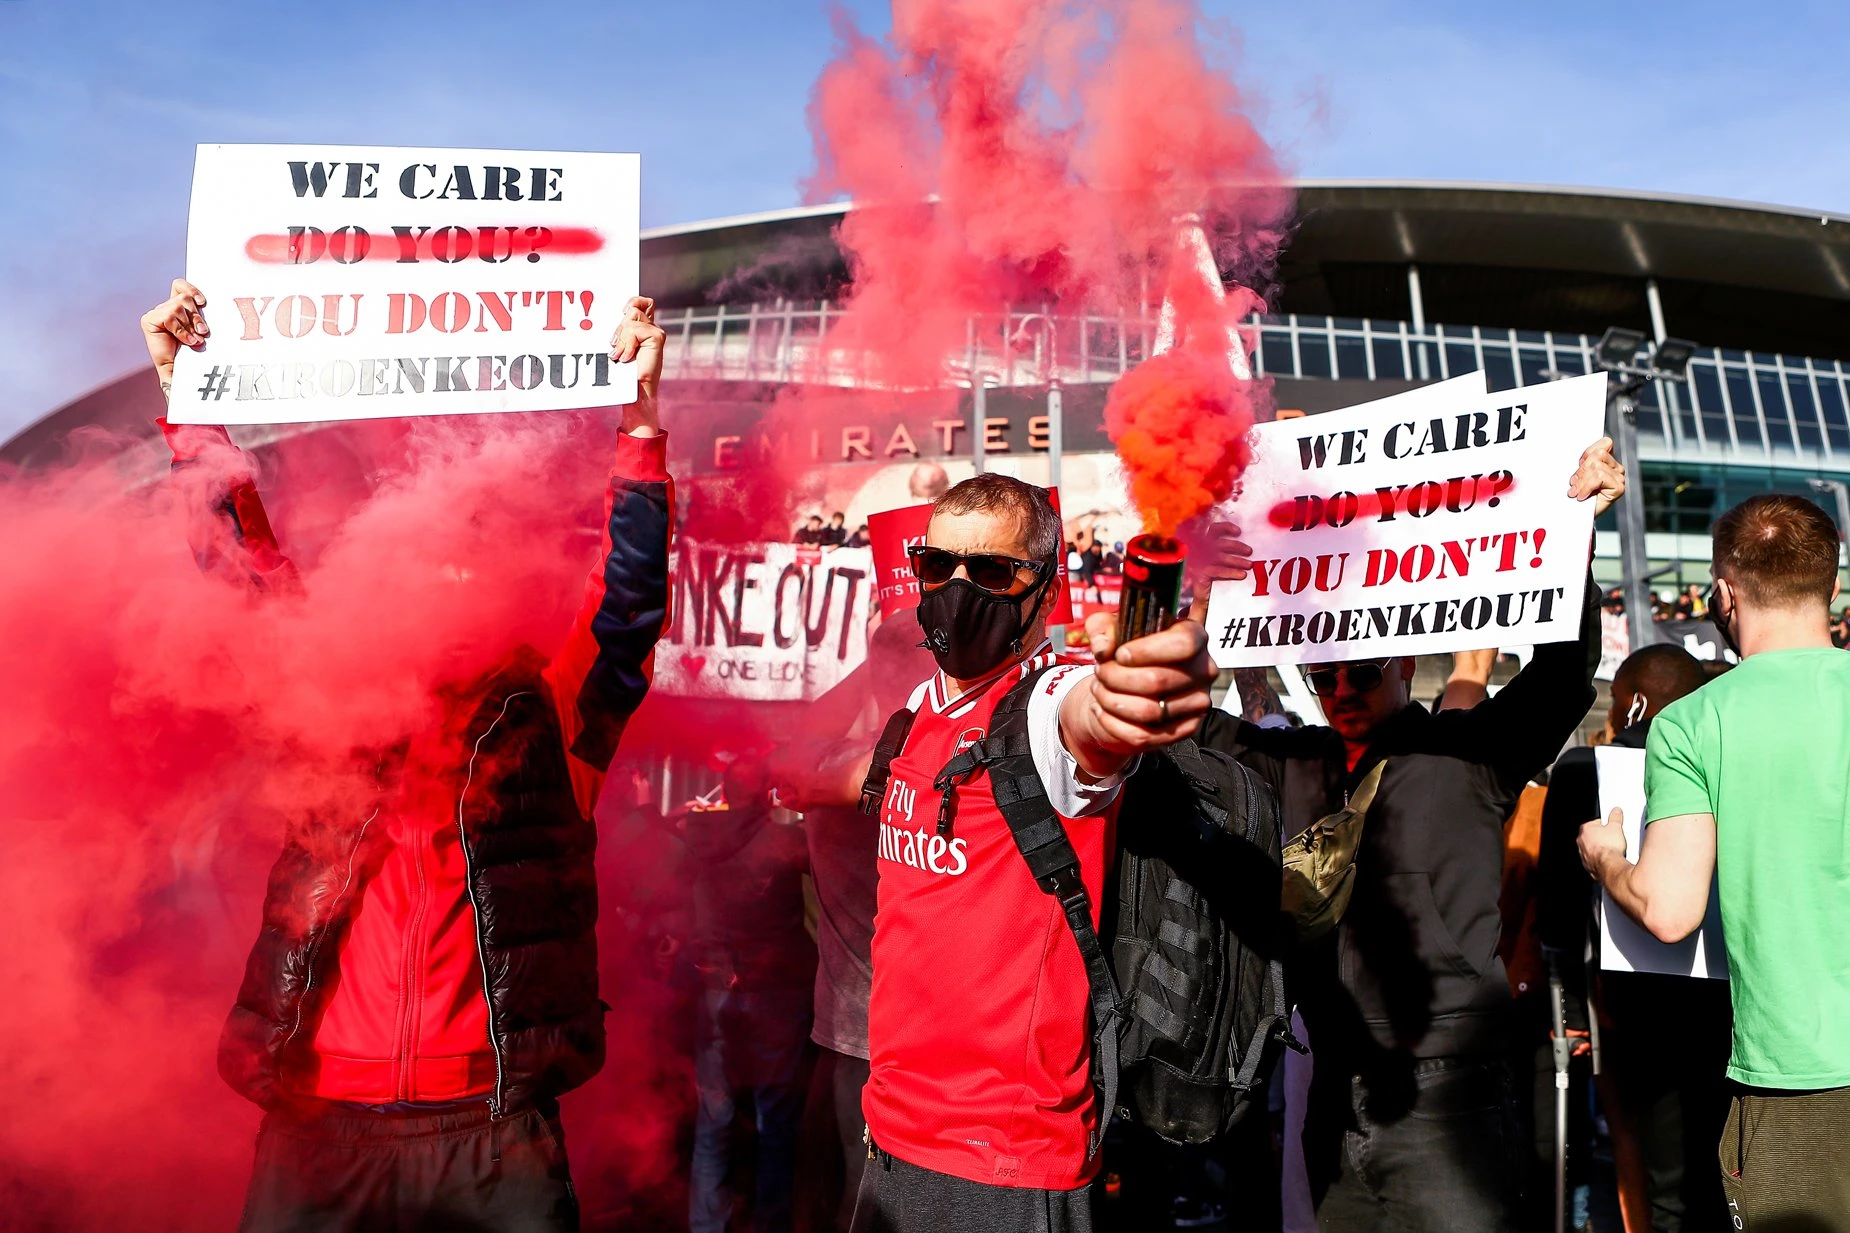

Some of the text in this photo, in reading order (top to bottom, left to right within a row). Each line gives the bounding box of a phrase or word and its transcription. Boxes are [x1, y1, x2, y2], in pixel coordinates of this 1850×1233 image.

[287, 162, 563, 202] WE CARE
[287, 225, 553, 264] DO YOU?
[233, 290, 594, 340] YOU DON'T!
[198, 352, 612, 401] #KROENKEOUT
[714, 416, 1049, 467] EMIRATES
[1297, 404, 1528, 471] WE CARE
[1290, 470, 1514, 532] DO YOU?
[1251, 528, 1547, 597] YOU DON'T!
[669, 545, 866, 660] NKE OUT
[880, 584, 904, 600] IT'S
[1219, 588, 1564, 649] #KROENKEOUT
[887, 779, 917, 822] Fly
[878, 814, 968, 876] mirates
